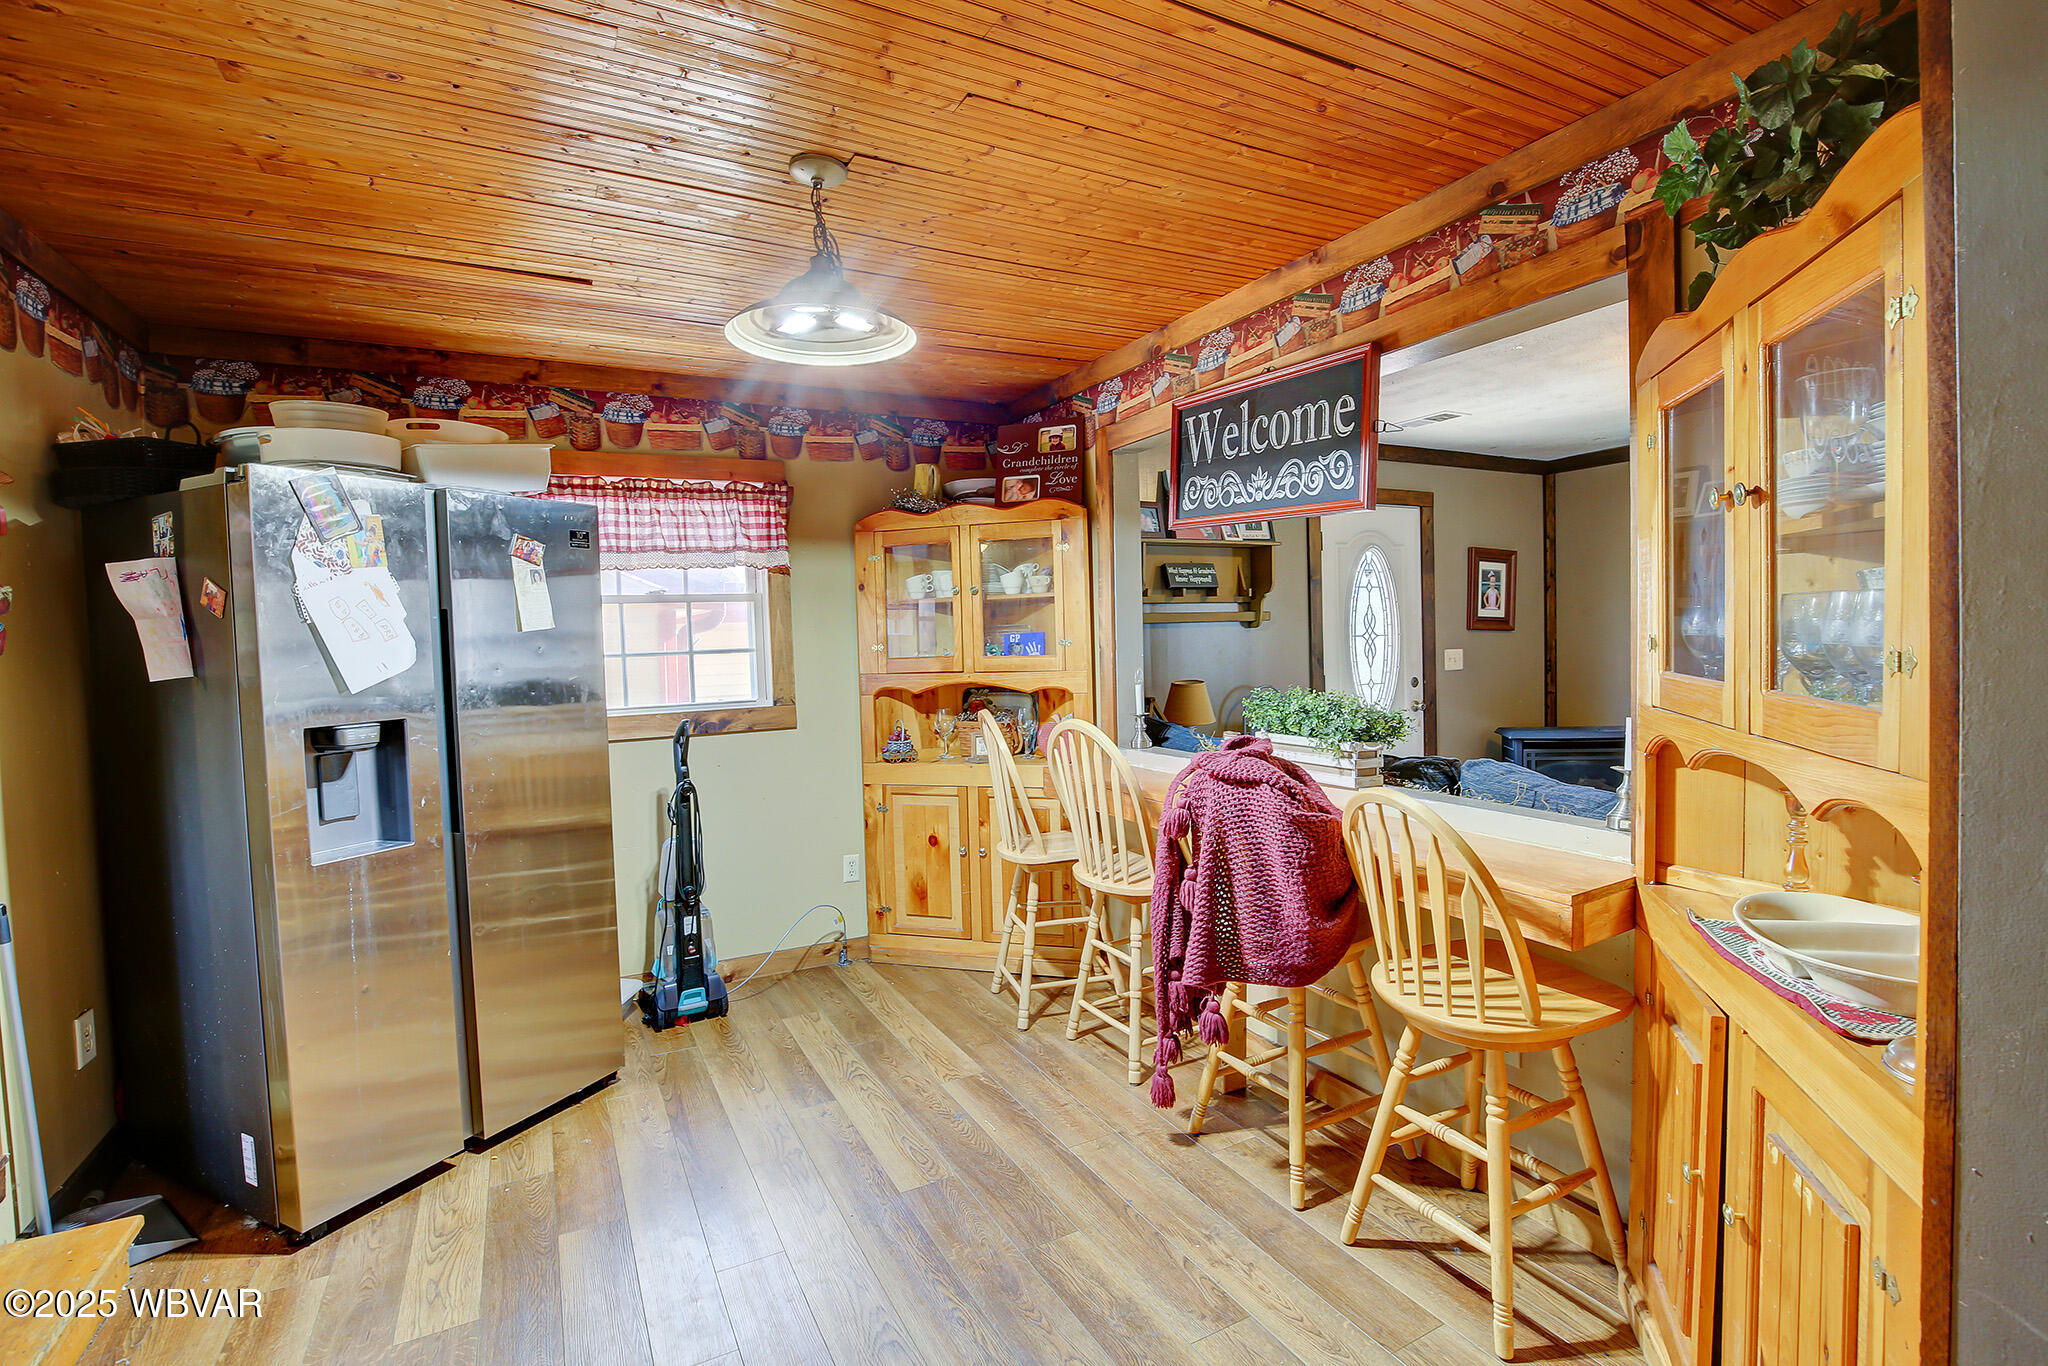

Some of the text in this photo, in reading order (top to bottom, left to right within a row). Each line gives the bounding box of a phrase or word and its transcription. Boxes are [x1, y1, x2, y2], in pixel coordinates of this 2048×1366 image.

[1184, 394, 1357, 468] Welcome
[1002, 454, 1078, 469] Grandchildren
[1019, 466, 1044, 474] complete
[1071, 462, 1079, 471] of
[1045, 471, 1078, 486] Love
